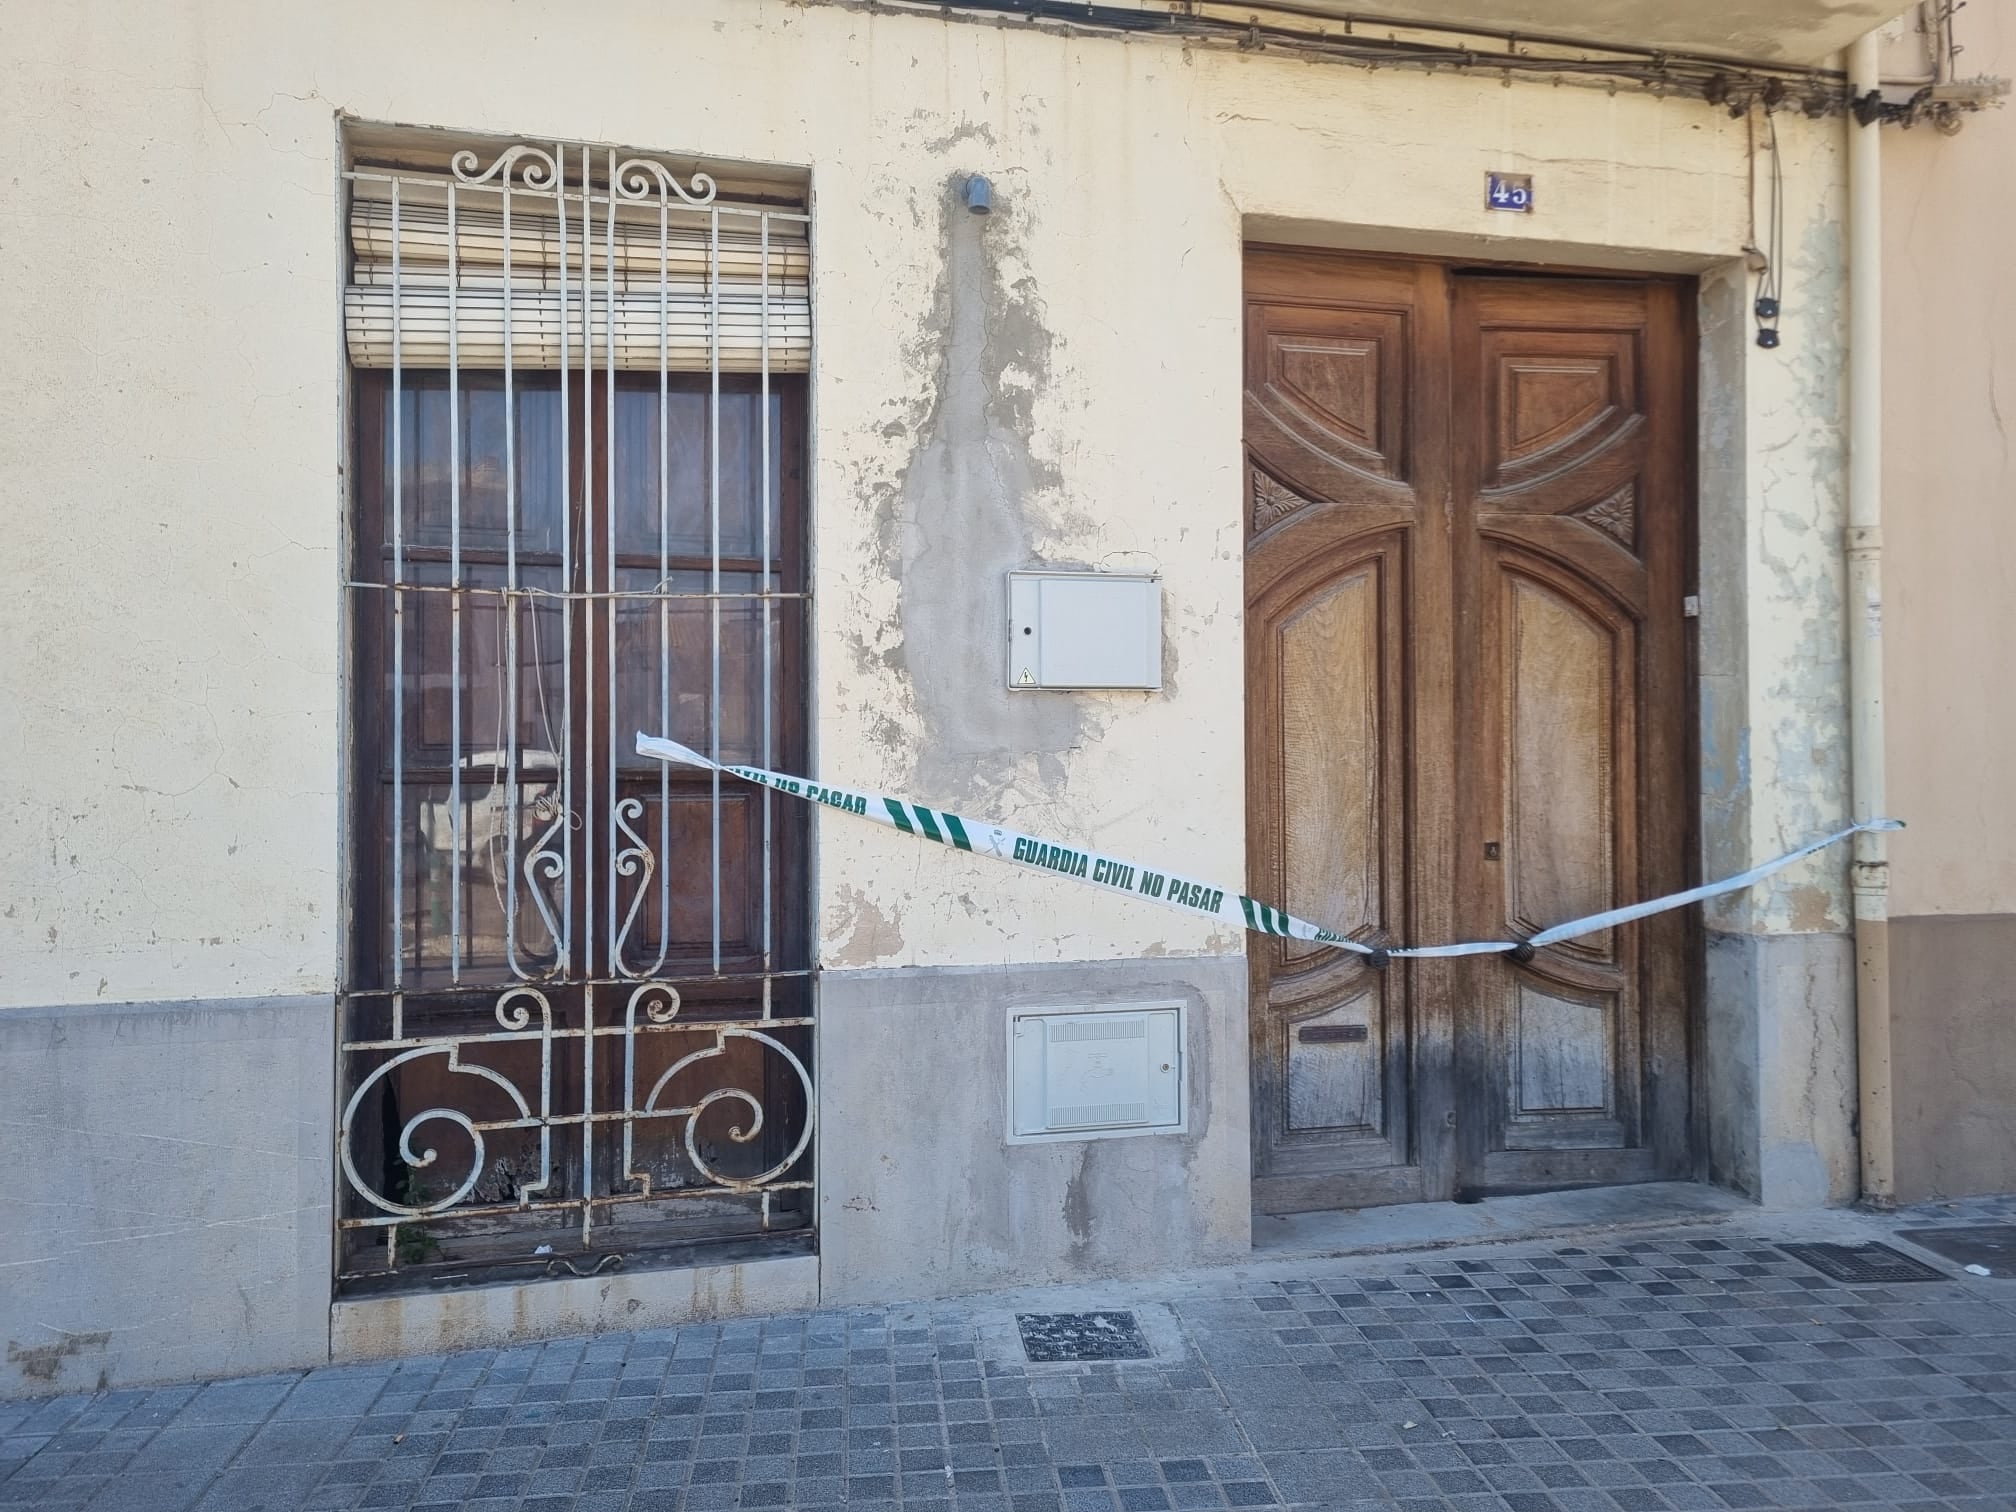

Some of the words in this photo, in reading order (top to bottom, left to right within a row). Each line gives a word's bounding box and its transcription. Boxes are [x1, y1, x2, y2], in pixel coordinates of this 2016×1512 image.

[1492, 179, 1527, 205] 45
[1012, 836, 1089, 878] GUARDIA
[1092, 858, 1135, 891] CIVIL
[1138, 870, 1165, 898] NO
[1166, 878, 1224, 914] PASAR
